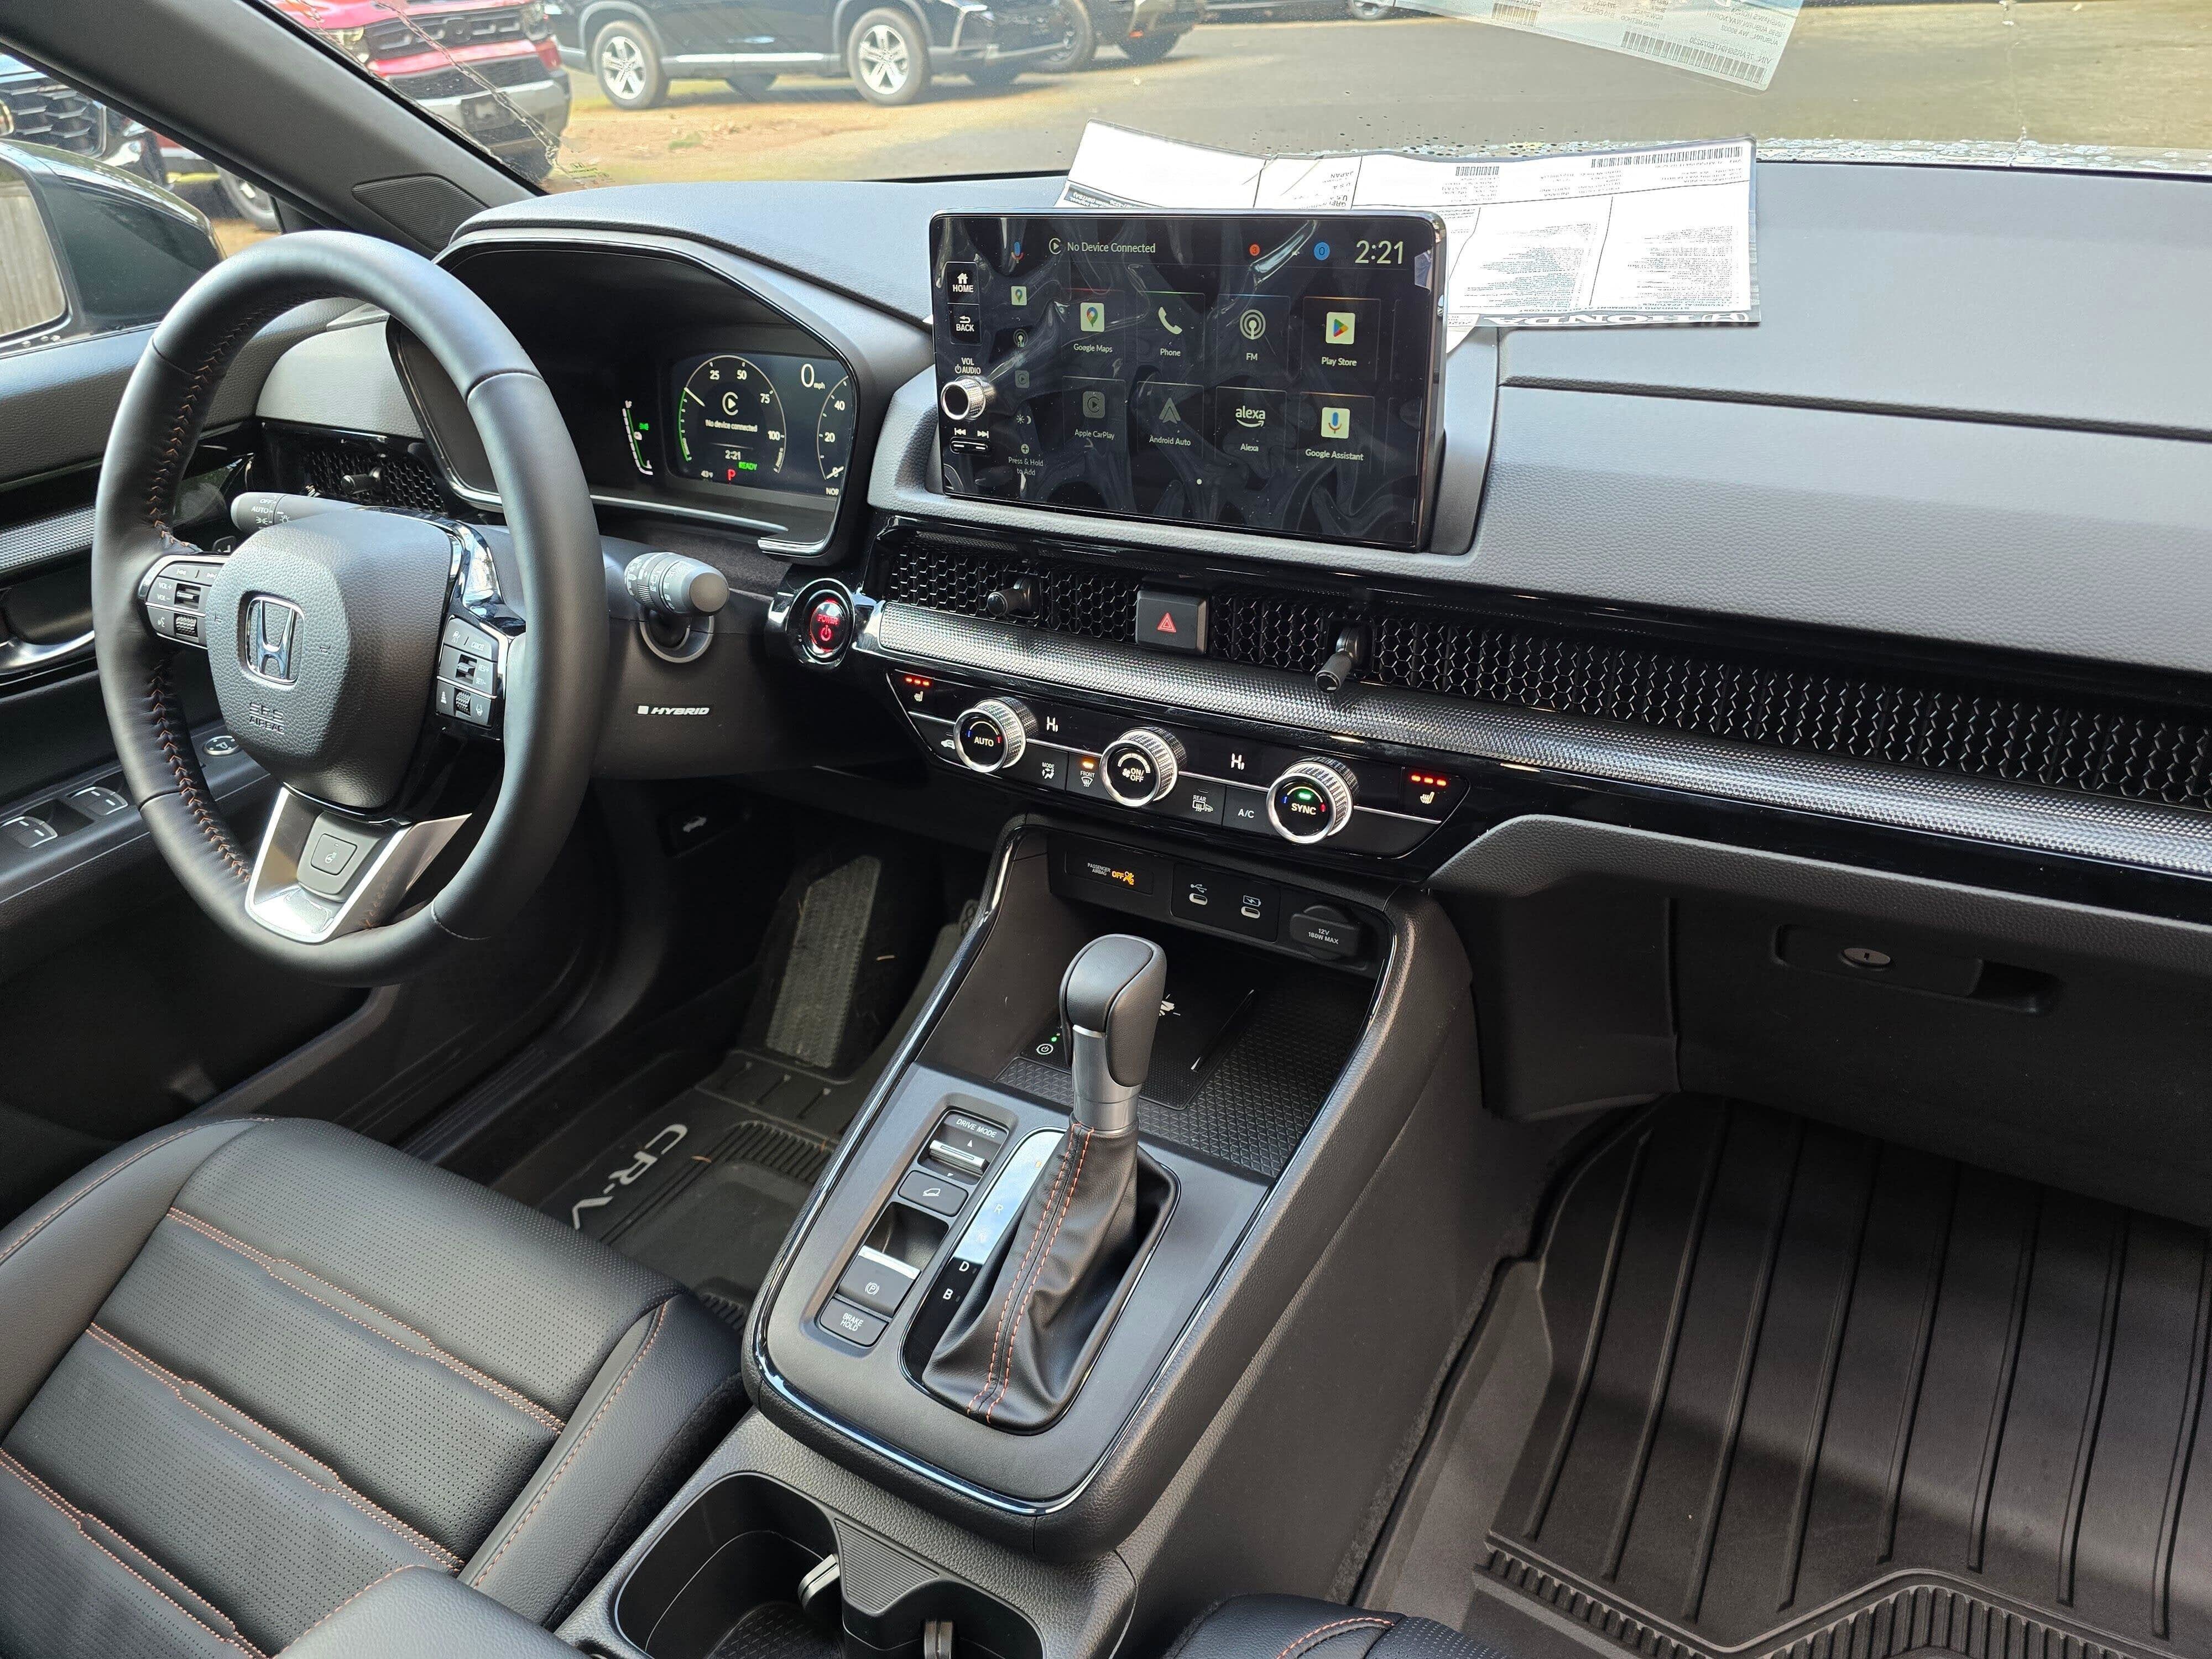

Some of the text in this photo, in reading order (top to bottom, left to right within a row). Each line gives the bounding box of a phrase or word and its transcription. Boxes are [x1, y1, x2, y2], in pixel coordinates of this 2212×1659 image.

[1067, 242, 1156, 253] No Device Connected
[1355, 240, 1404, 264] 2:21
[952, 284, 974, 293] HOME
[956, 324, 974, 332] BACK
[1073, 344, 1113, 354] Google Maps
[1160, 348, 1181, 357] Phone
[961, 357, 974, 366] VOL
[1246, 352, 1258, 361] FM
[1321, 356, 1357, 366] Play Store
[709, 369, 719, 380] 25
[737, 369, 747, 380] 50
[801, 363, 815, 388] 0
[962, 366, 981, 374] AUDIO
[813, 382, 826, 390] mph
[760, 393, 770, 404] 75
[834, 400, 846, 411] 40
[1235, 405, 1265, 420] alexa
[768, 430, 780, 441] 100
[825, 432, 836, 443] 20
[1074, 429, 1115, 441] Apple CarPlay
[1149, 435, 1191, 446] Android Auto
[1240, 443, 1259, 452] Alexa
[725, 450, 741, 460] 2:21
[1305, 448, 1364, 461] Google Assistant
[1009, 457, 1022, 465] Press
[1030, 458, 1044, 467] Hold
[728, 468, 736, 481] P
[251, 505, 269, 514] AUTO
[817, 613, 839, 625] POWER
[651, 707, 710, 715] HYBRID
[974, 735, 994, 747] AUTO
[1130, 767, 1144, 776] ON/
[1238, 808, 1255, 818] A/C
[1291, 803, 1317, 815] SYNC
[1087, 862, 1111, 873] PASSENGER
[1112, 870, 1124, 879] OFF
[1308, 931, 1339, 945] 180W MAX
[956, 1118, 998, 1138] DRIVE MODE
[572, 1124, 688, 1230] CR-V
[994, 1204, 1004, 1215] R
[959, 1261, 970, 1272] D
[942, 1288, 953, 1300] B
[842, 1313, 864, 1327] BRAKE
[840, 1320, 858, 1332] HOLD
